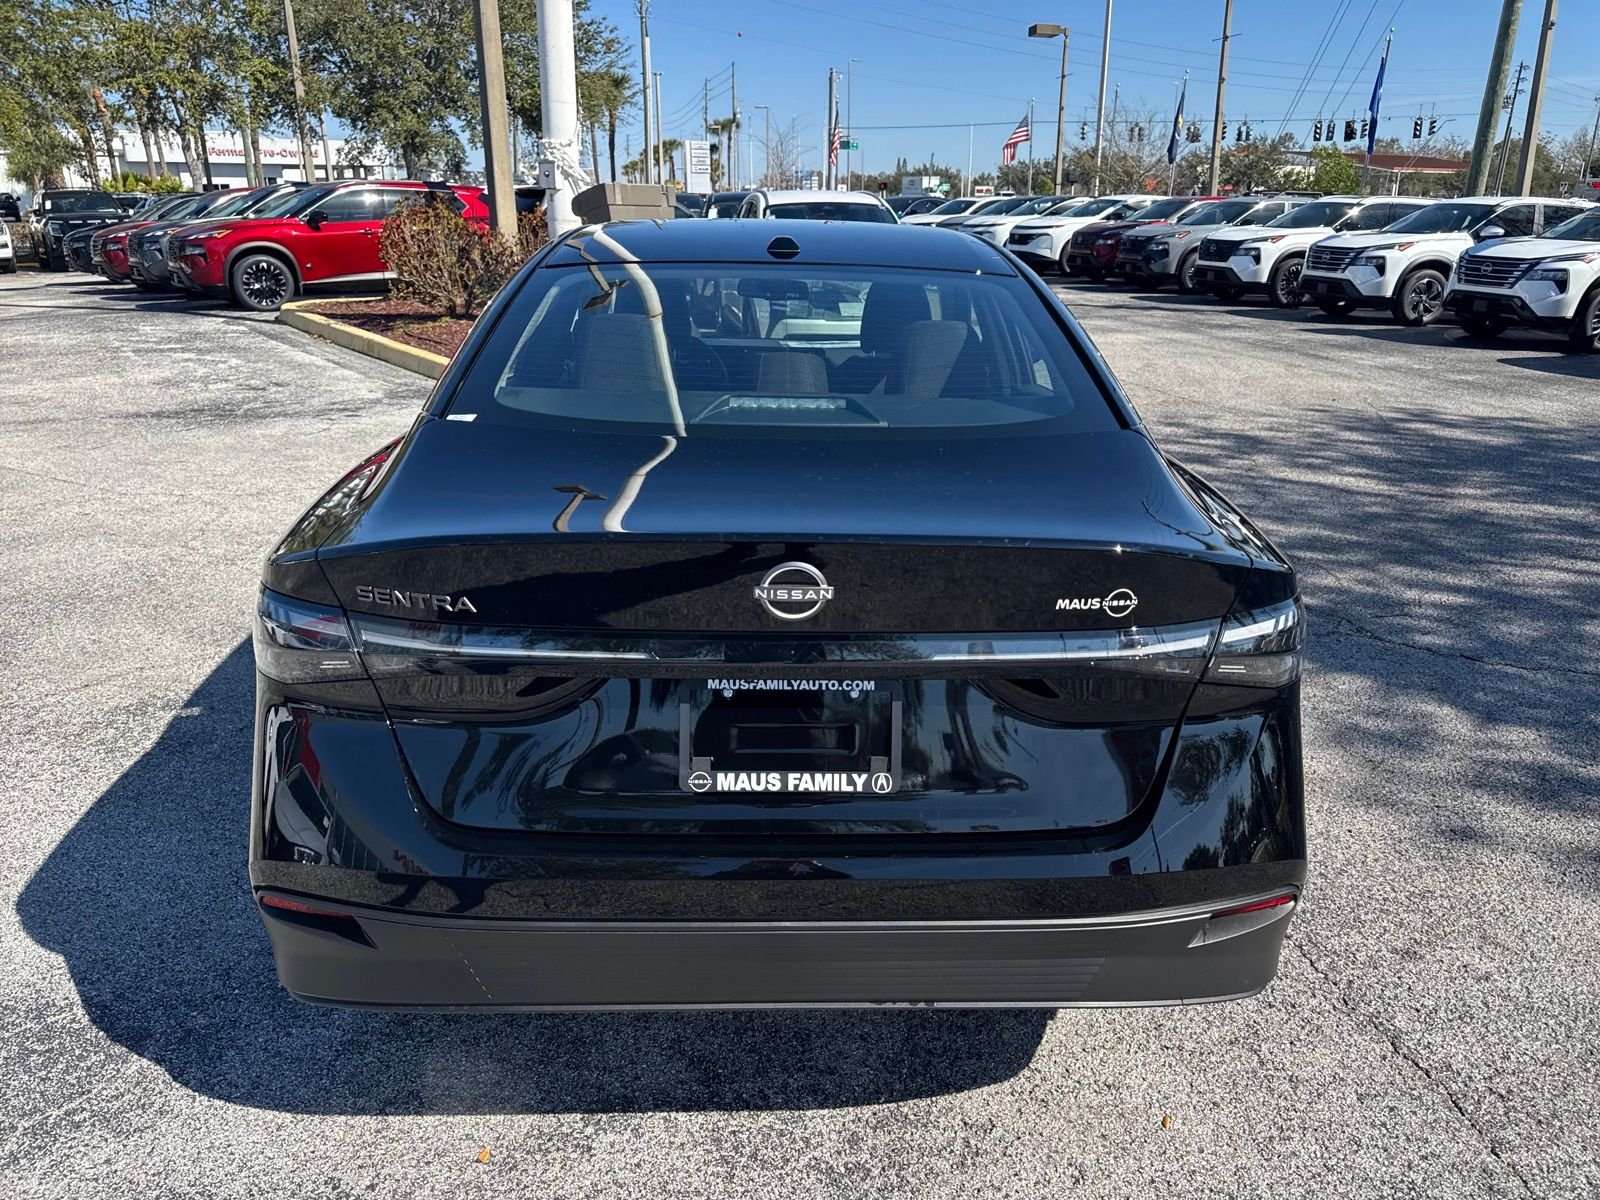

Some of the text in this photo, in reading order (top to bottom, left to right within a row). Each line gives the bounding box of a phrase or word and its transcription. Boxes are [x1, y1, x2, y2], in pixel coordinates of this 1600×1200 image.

[208, 146, 245, 157] Ferma
[355, 584, 477, 613] SENTRA
[755, 588, 832, 600] NISSAN
[1055, 598, 1138, 610] MAUS NISSAN
[707, 679, 875, 691] MAUSFAMILYAUTO.COM
[716, 772, 782, 791] MAUS
[788, 772, 869, 791] FAMILY
